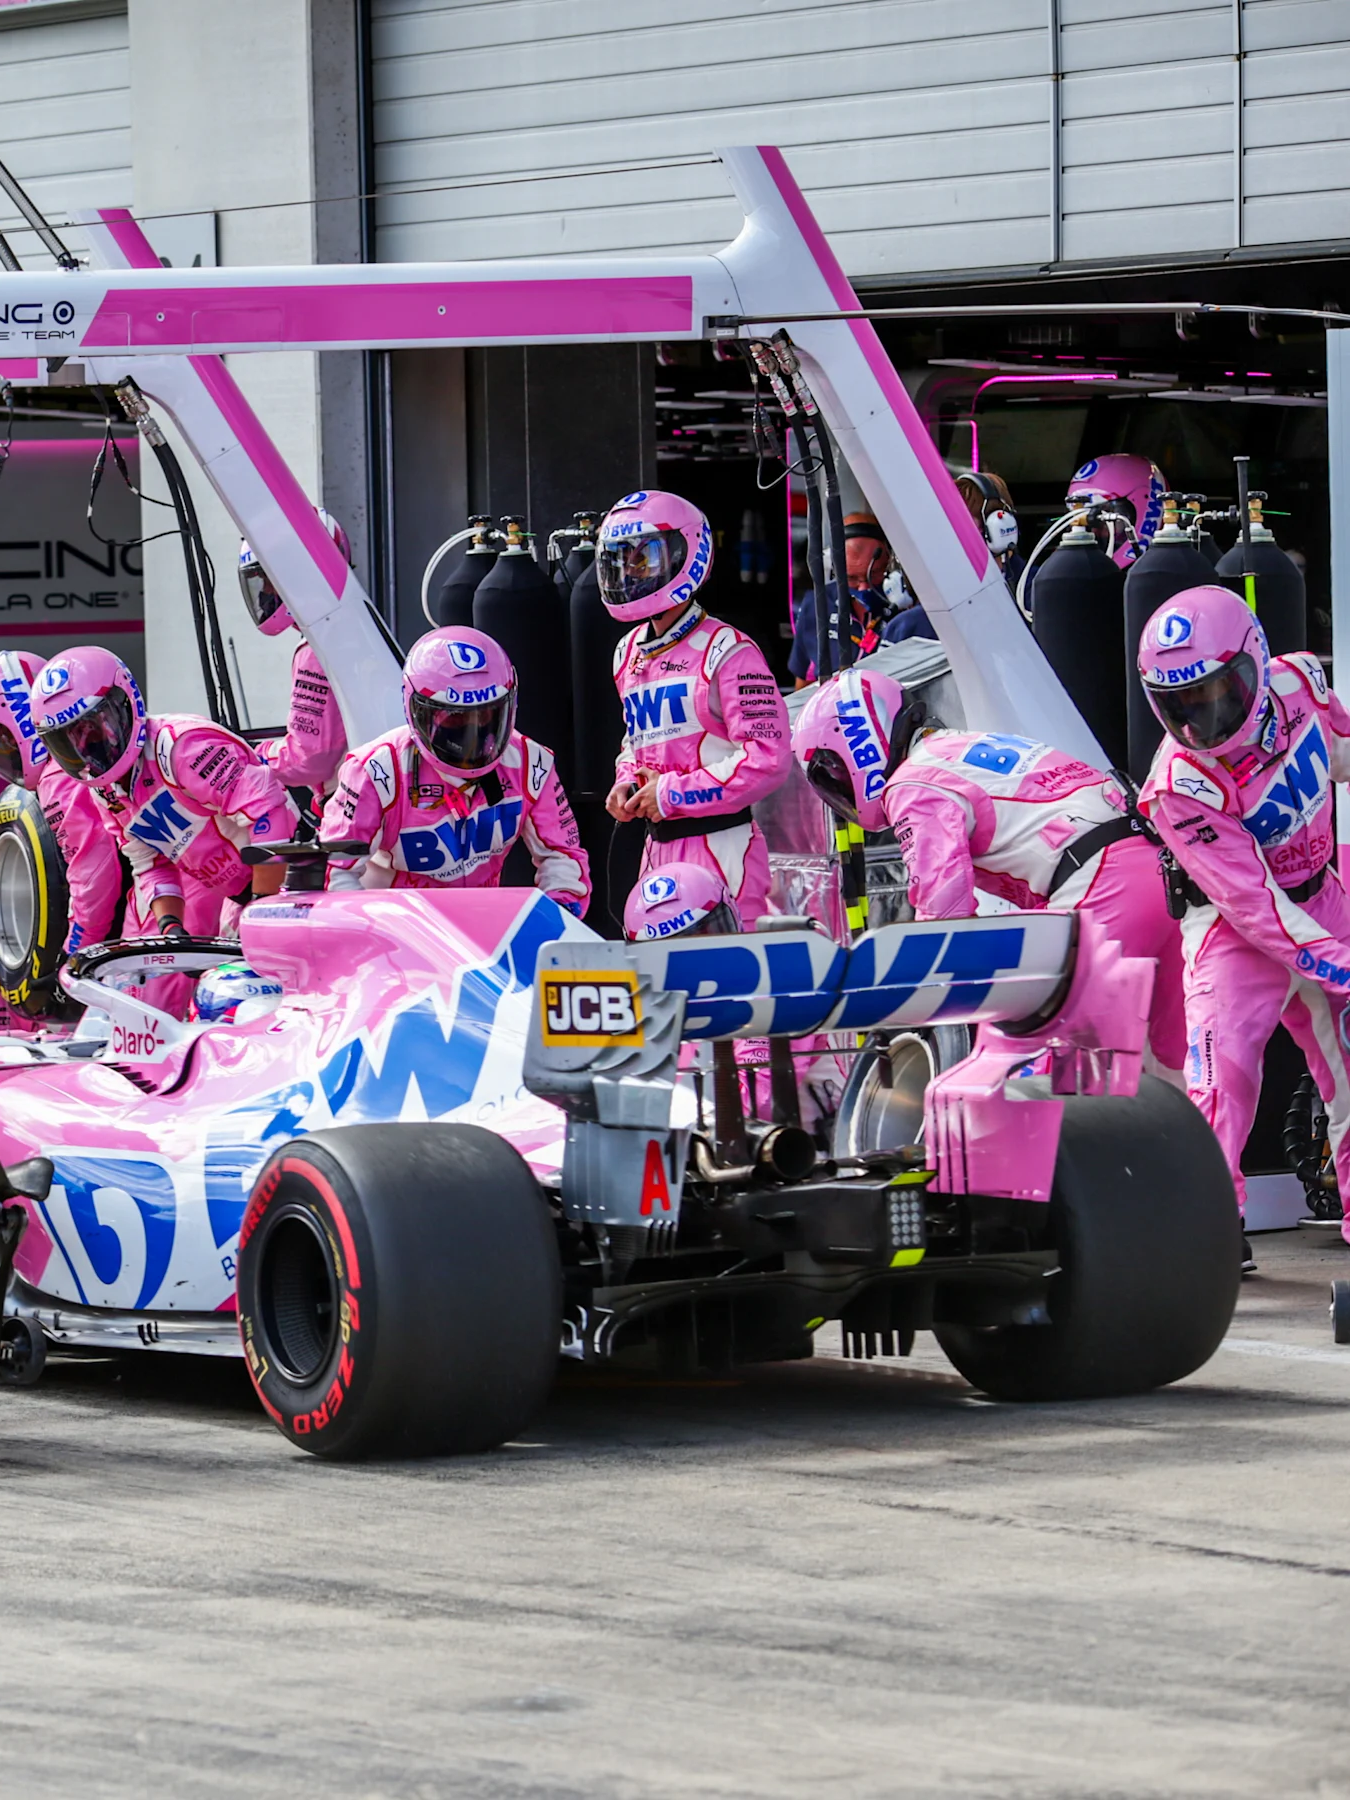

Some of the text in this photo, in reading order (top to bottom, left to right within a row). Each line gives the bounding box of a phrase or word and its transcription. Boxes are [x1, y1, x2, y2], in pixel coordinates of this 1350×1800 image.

[30, 330, 75, 341] TEAM
[611, 521, 643, 538] BWT
[687, 522, 713, 586] BWT
[44, 592, 119, 609] ONE
[660, 660, 684, 672] Claro
[737, 673, 774, 682] Infinitum
[1167, 660, 1207, 684] BWT
[293, 692, 327, 705] CHOPARD
[295, 678, 330, 695] PIRELLI
[462, 684, 498, 704] BWT
[738, 686, 775, 696] PIRELLI
[0, 677, 38, 739] BWT
[57, 697, 88, 725] BWT
[294, 716, 315, 727] AQUA
[624, 683, 688, 737] BWT
[744, 731, 783, 740] MONDO
[751, 723, 776, 731] AQUA
[836, 698, 886, 770] BWT
[198, 746, 229, 780] PIRELLI
[209, 755, 237, 787] CHOPARD
[418, 784, 444, 798] CB
[683, 786, 724, 806] BWT
[129, 789, 193, 851] WT
[400, 800, 523, 873] BWT
[1266, 834, 1330, 867] AGNES
[1273, 854, 1325, 875] RALIZED
[658, 909, 696, 937] BWT
[143, 955, 175, 966] 11 PER
[1315, 958, 1350, 989] BW
[664, 927, 1025, 1040] BWT
[547, 985, 636, 1032] JCB
[113, 1025, 155, 1056] Claro
[1205, 1029, 1213, 1086] Simpson
[639, 1139, 671, 1216] A
[239, 1156, 285, 1251] PIRELLI
[292, 1288, 361, 1435] P ZERO
